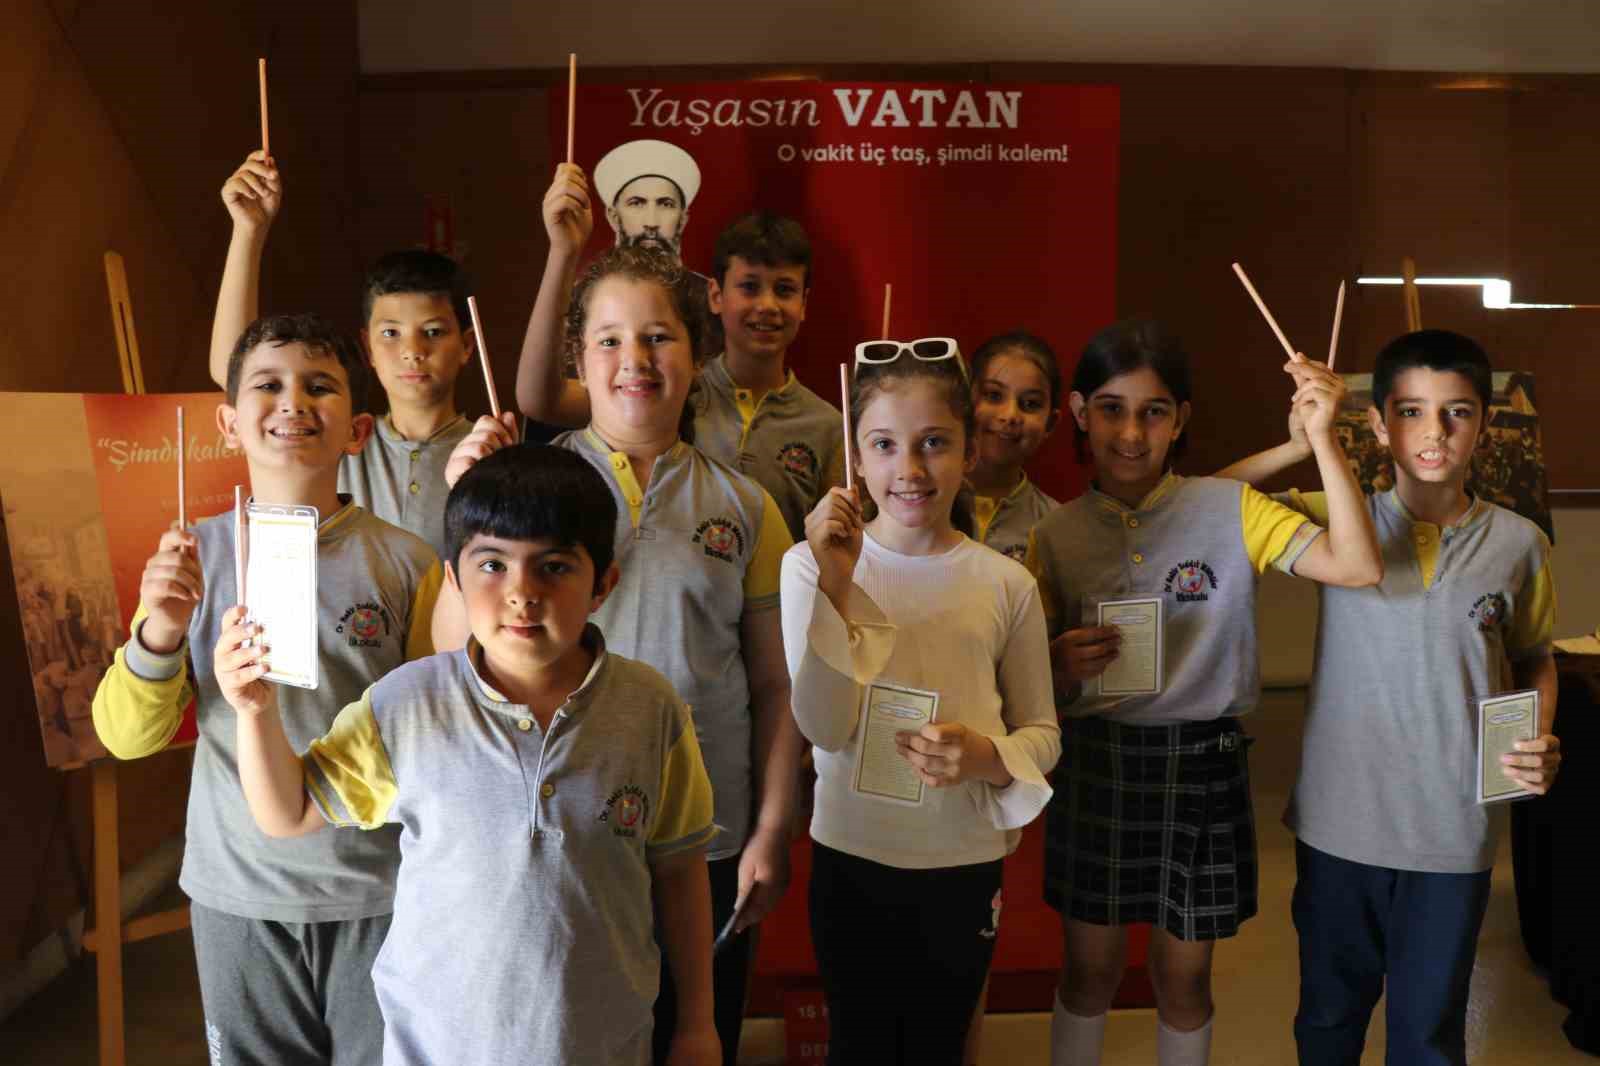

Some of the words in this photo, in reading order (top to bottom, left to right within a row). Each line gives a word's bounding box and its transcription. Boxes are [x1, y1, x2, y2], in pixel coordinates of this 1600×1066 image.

[627, 87, 821, 135] Yaşasın
[832, 88, 1023, 129] VATAN
[777, 144, 796, 162] O
[801, 143, 855, 162] vakit
[859, 142, 886, 167] üç
[890, 144, 931, 166] taş,
[936, 143, 993, 166] şimdi
[998, 143, 1069, 163] kalem!
